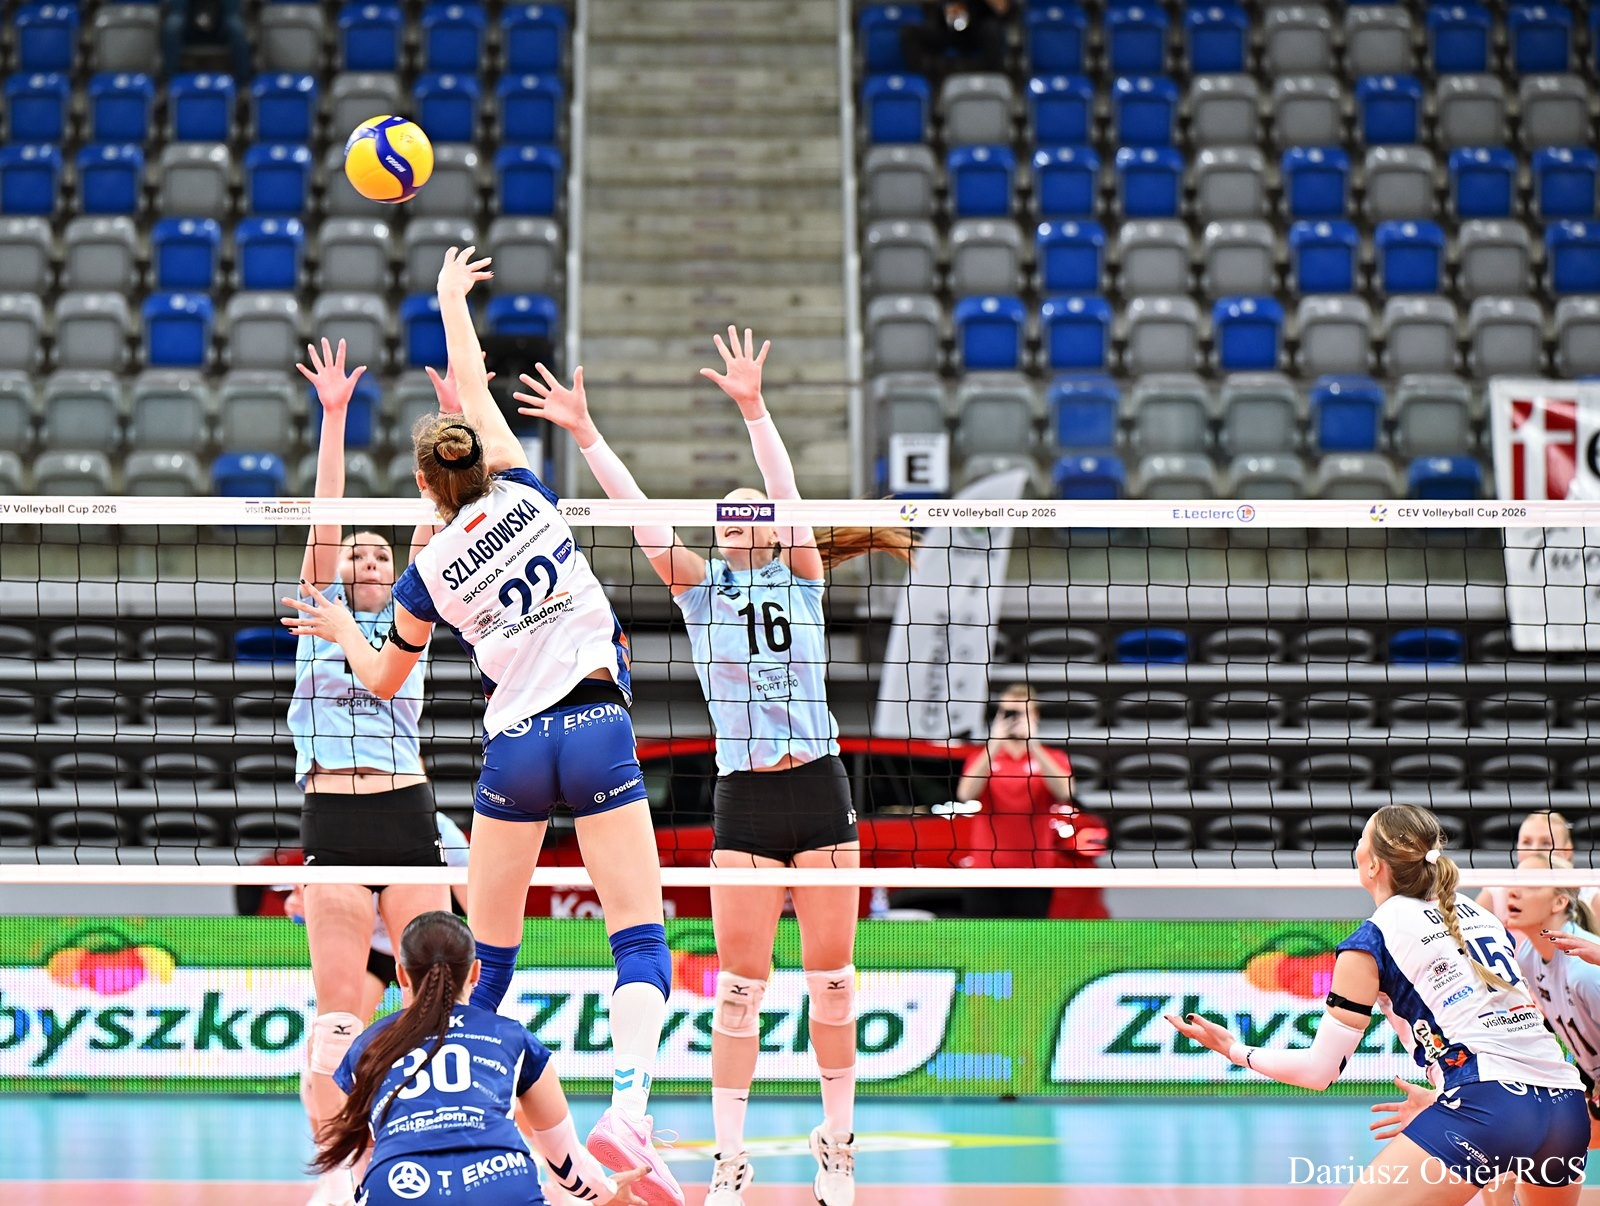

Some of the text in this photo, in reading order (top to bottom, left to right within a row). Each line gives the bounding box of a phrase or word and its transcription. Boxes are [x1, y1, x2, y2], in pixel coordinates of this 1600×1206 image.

[905, 453, 931, 483] E
[13, 504, 65, 515] Volleyball
[67, 504, 90, 515] Cup
[92, 505, 117, 514] 2026
[566, 507, 591, 516] 2026
[721, 504, 772, 521] moya
[928, 508, 1057, 519] CEV Volleyball Cup 2026
[1172, 509, 1235, 519] E.Leclerc
[1397, 508, 1527, 519] CEV Volleyball Cup 2026
[442, 499, 541, 591] SZLAGOWSKA
[516, 542, 531, 556] AUTO
[530, 523, 551, 543] CENTRUM
[498, 555, 558, 617] 22
[738, 601, 792, 655] 16
[1433, 971, 1463, 991] PIEKARNIA
[1443, 989, 1469, 1008] AKCES
[465, 1034, 502, 1045] CENTRUM
[1556, 1014, 1598, 1057] 11
[391, 1044, 471, 1099] 30
